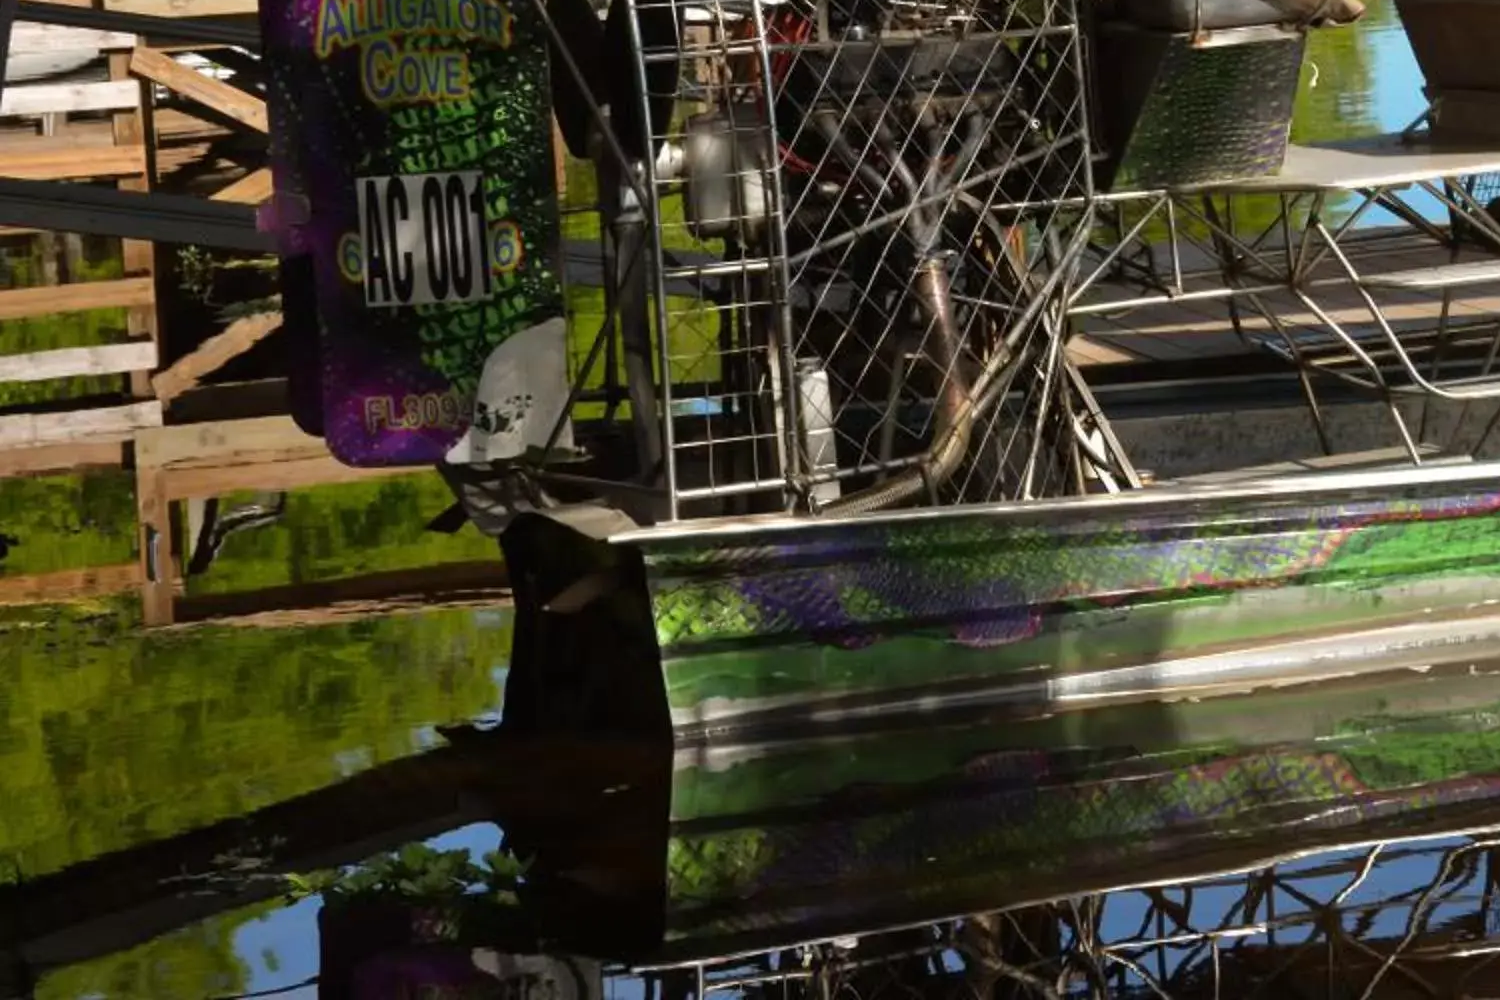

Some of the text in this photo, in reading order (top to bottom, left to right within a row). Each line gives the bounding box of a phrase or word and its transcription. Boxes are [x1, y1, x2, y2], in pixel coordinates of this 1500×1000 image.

[364, 41, 465, 100] COVE
[366, 175, 491, 302] AC 001
